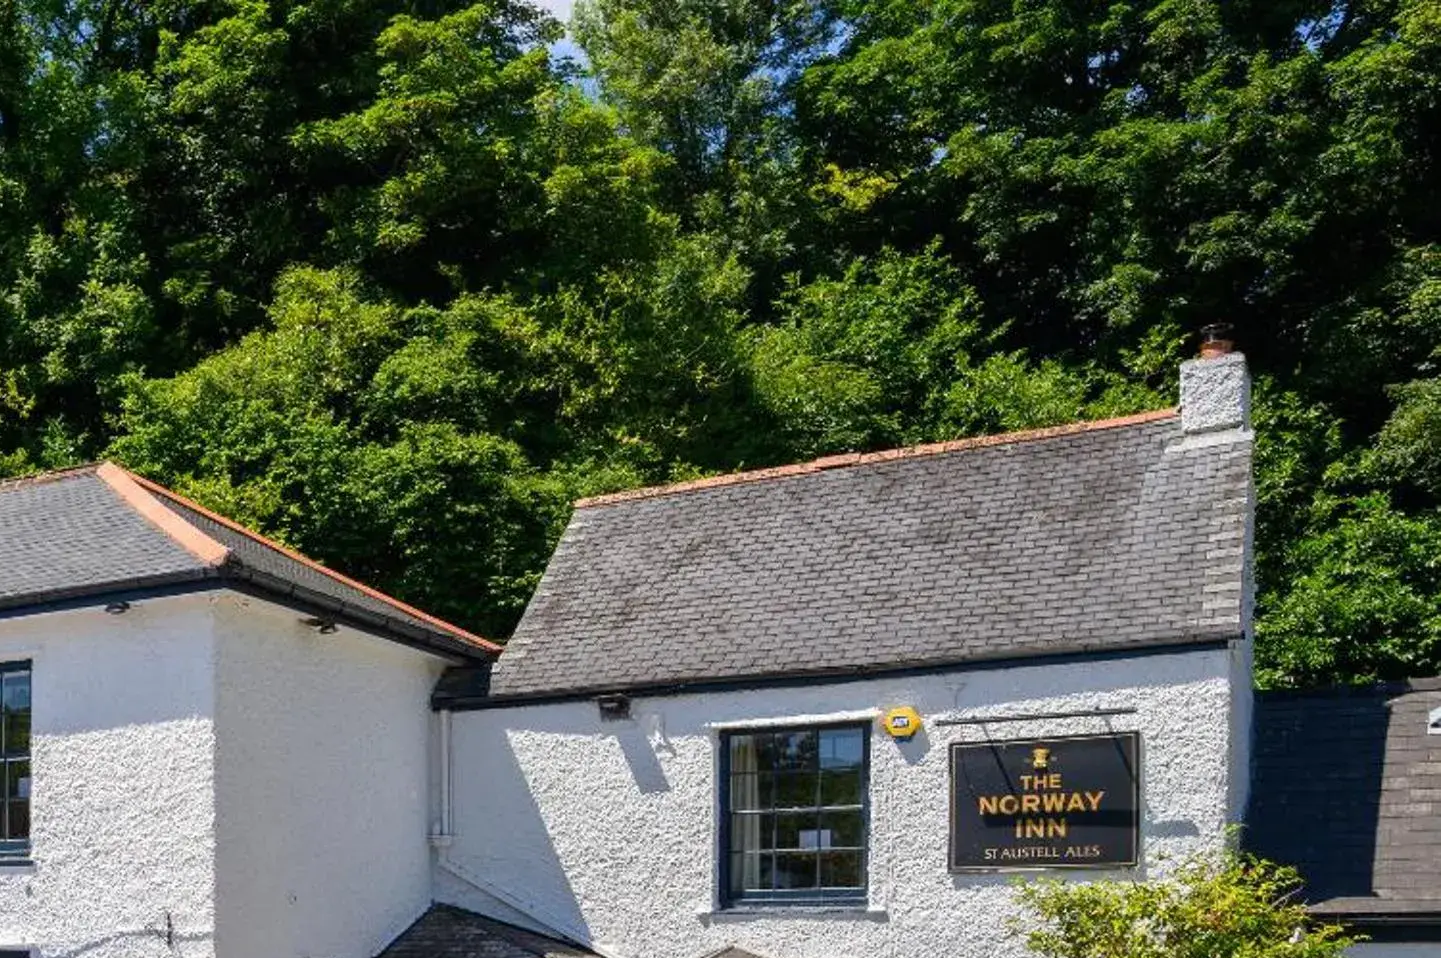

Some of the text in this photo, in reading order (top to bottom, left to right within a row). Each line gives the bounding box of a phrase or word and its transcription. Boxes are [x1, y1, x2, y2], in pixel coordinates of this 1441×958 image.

[1019, 773, 1062, 790] THE
[978, 791, 1105, 815] NORWAY
[1015, 818, 1068, 838] INN
[984, 845, 1101, 860] ST AUSTELL ALES
